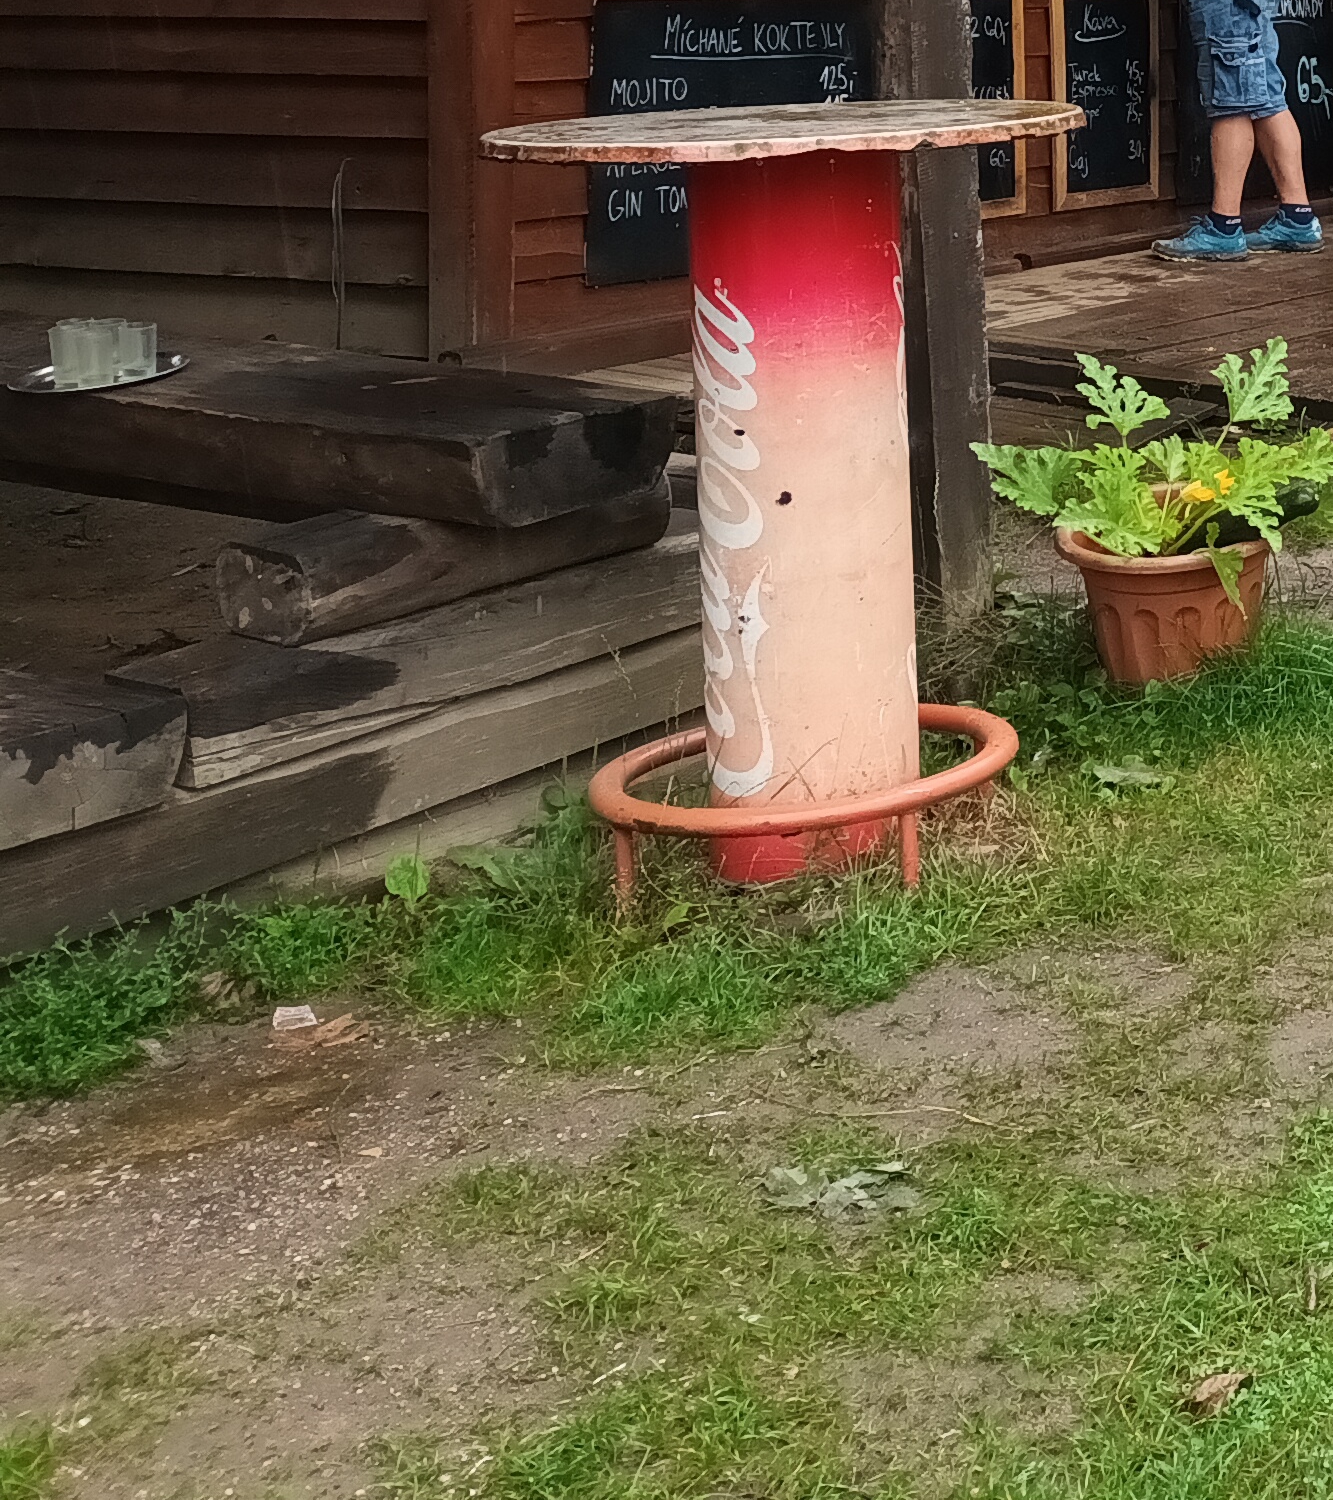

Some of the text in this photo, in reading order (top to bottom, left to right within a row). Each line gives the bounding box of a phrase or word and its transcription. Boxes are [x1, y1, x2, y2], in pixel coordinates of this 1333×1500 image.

[664, 14, 847, 54] MÍCHANÉ KOKTEJLY
[610, 78, 688, 107] MOJITO
[608, 188, 643, 221] GIN
